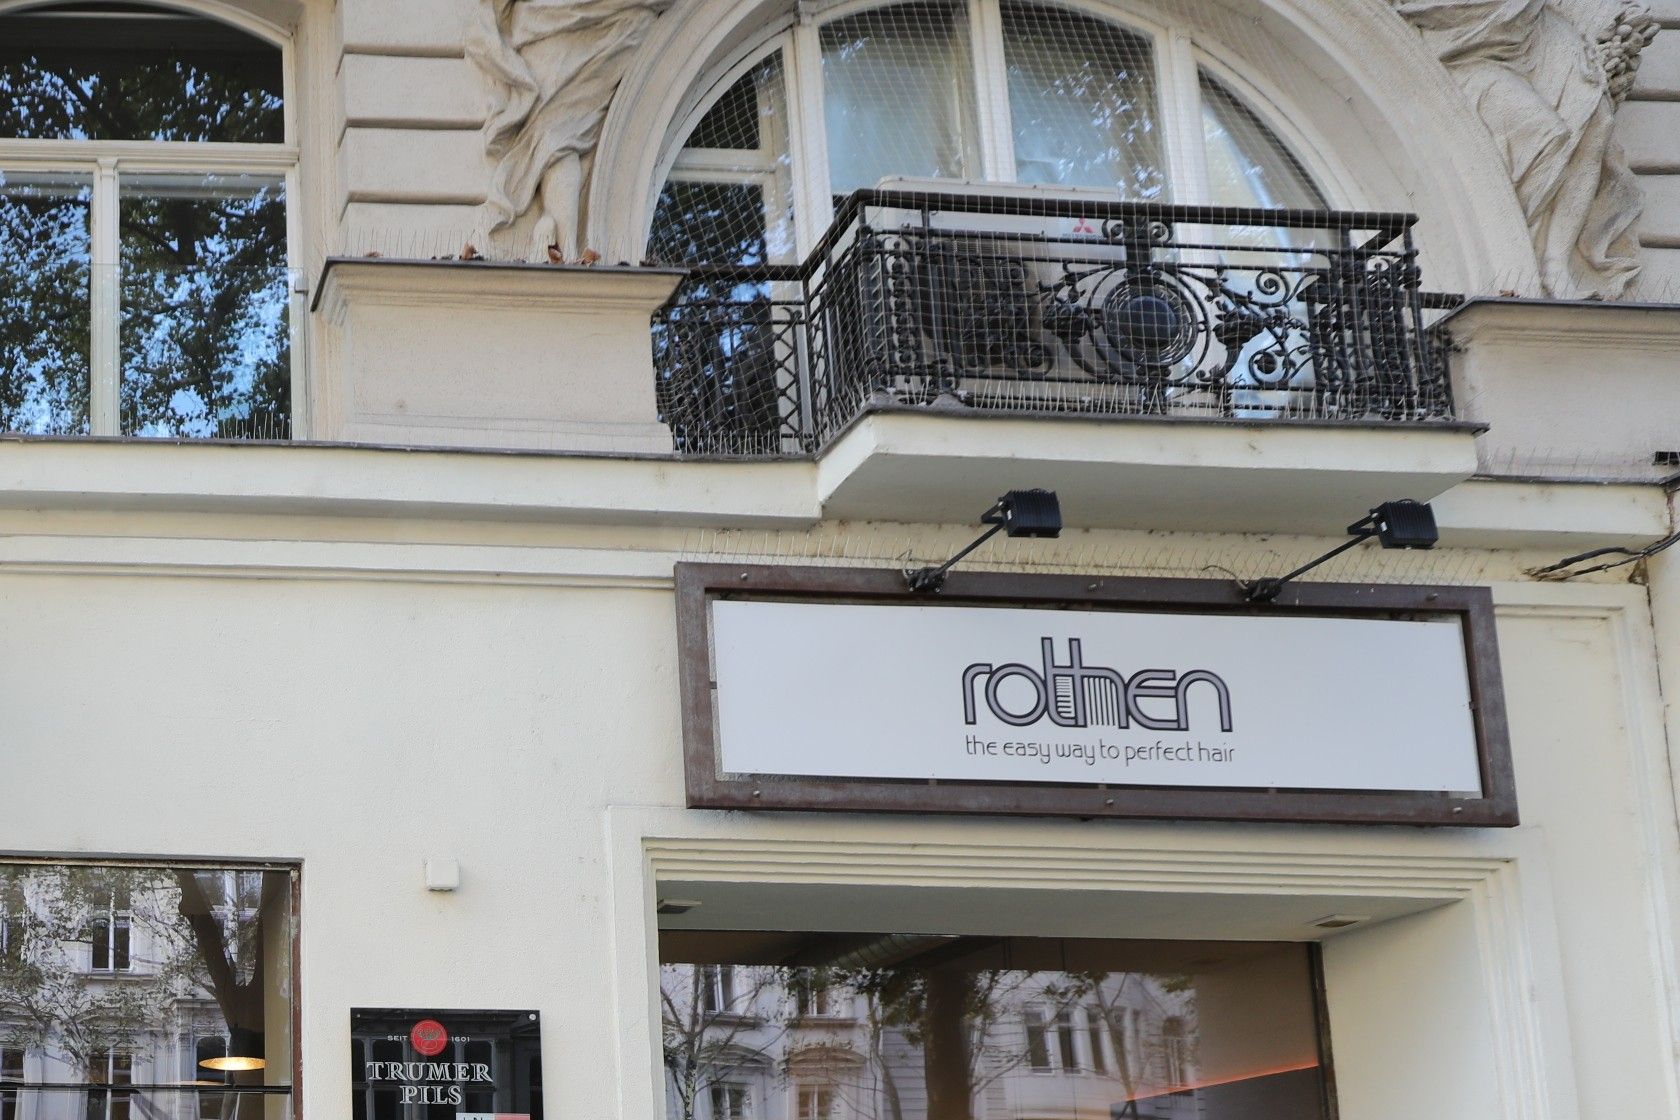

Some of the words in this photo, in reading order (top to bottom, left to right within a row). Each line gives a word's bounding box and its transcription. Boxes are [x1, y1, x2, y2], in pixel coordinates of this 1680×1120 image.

[962, 636, 1234, 733] rothen
[965, 734, 998, 756] the
[1003, 741, 1051, 766] easy
[1055, 742, 1096, 767] way
[1099, 738, 1120, 760] to
[1125, 740, 1195, 767] perfect
[1197, 741, 1236, 763] hair
[387, 1034, 408, 1042] SEIT
[450, 1035, 471, 1043] 1601
[366, 1061, 494, 1083] TRUMER
[399, 1085, 463, 1106] PILS
